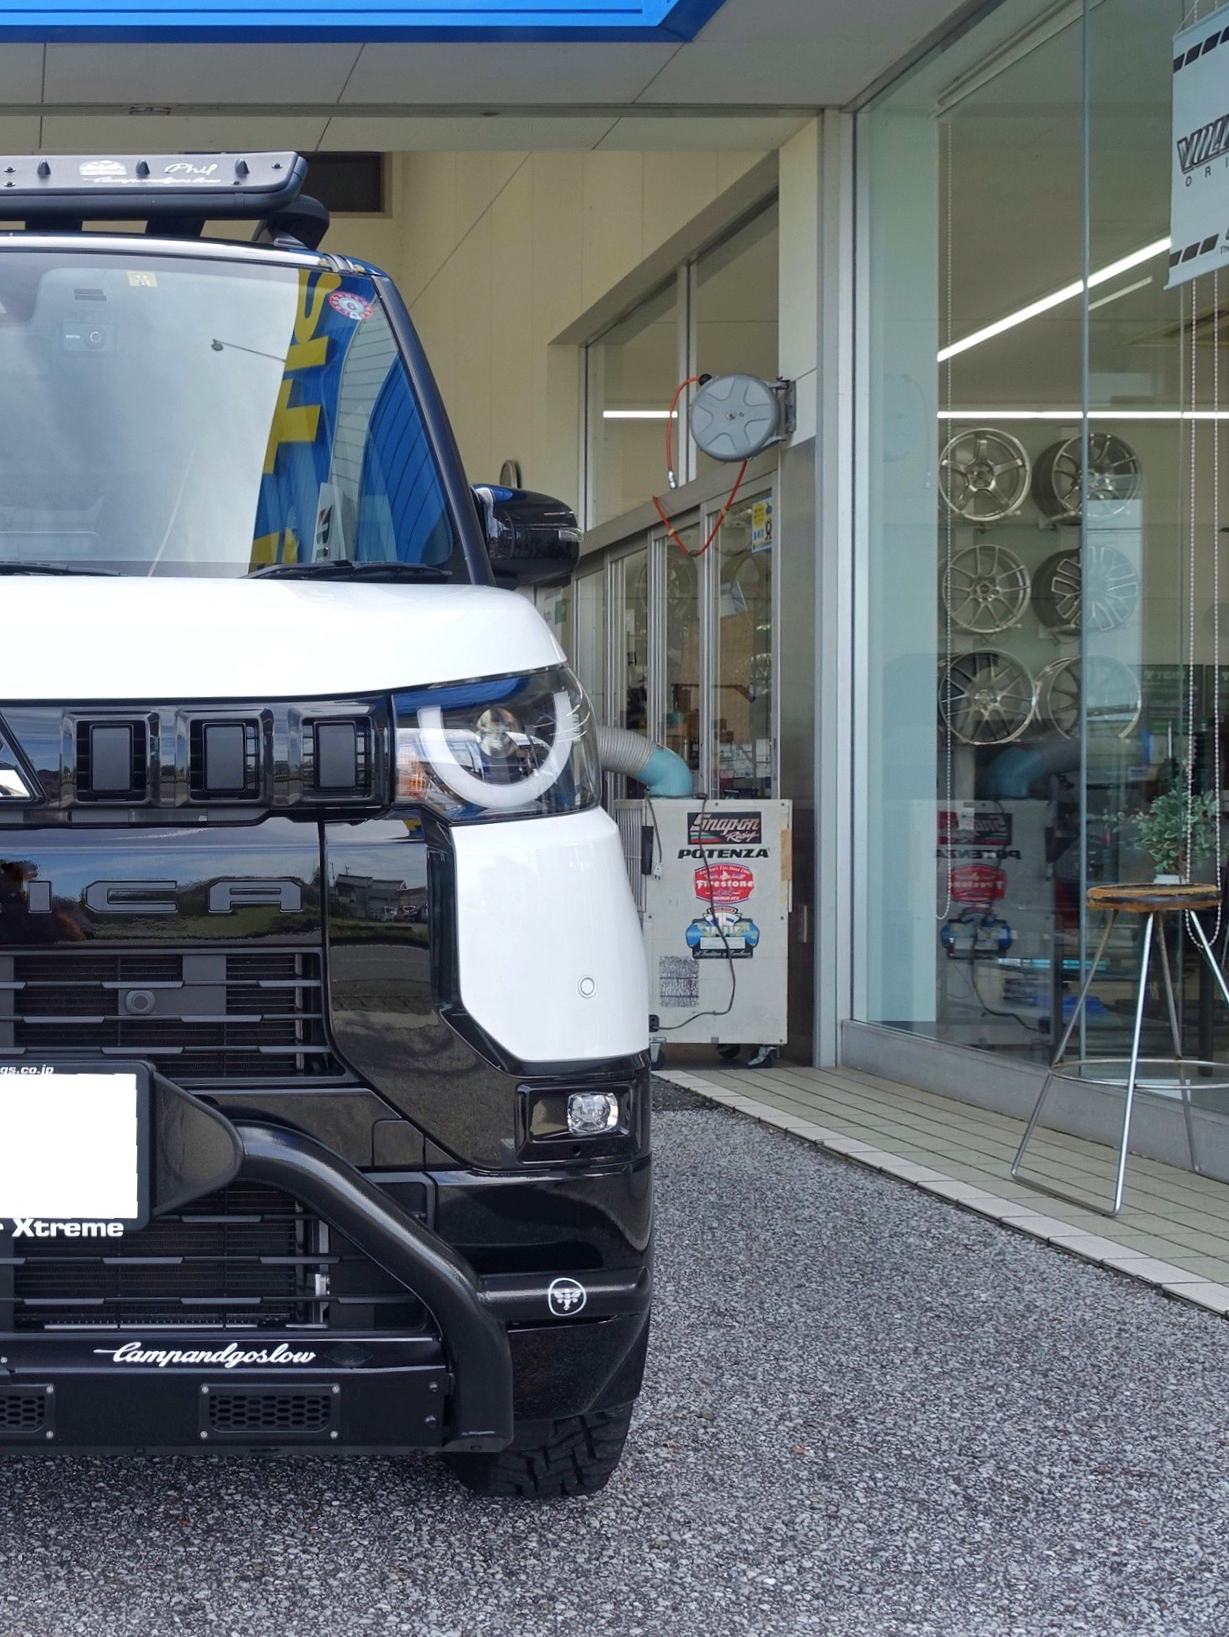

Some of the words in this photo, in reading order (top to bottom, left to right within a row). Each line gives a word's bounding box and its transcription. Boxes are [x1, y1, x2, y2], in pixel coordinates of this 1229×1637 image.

[677, 848, 770, 860] POTENZA
[11, 1217, 124, 1239] Xtreme
[93, 1341, 317, 1368] Campandgoslow
